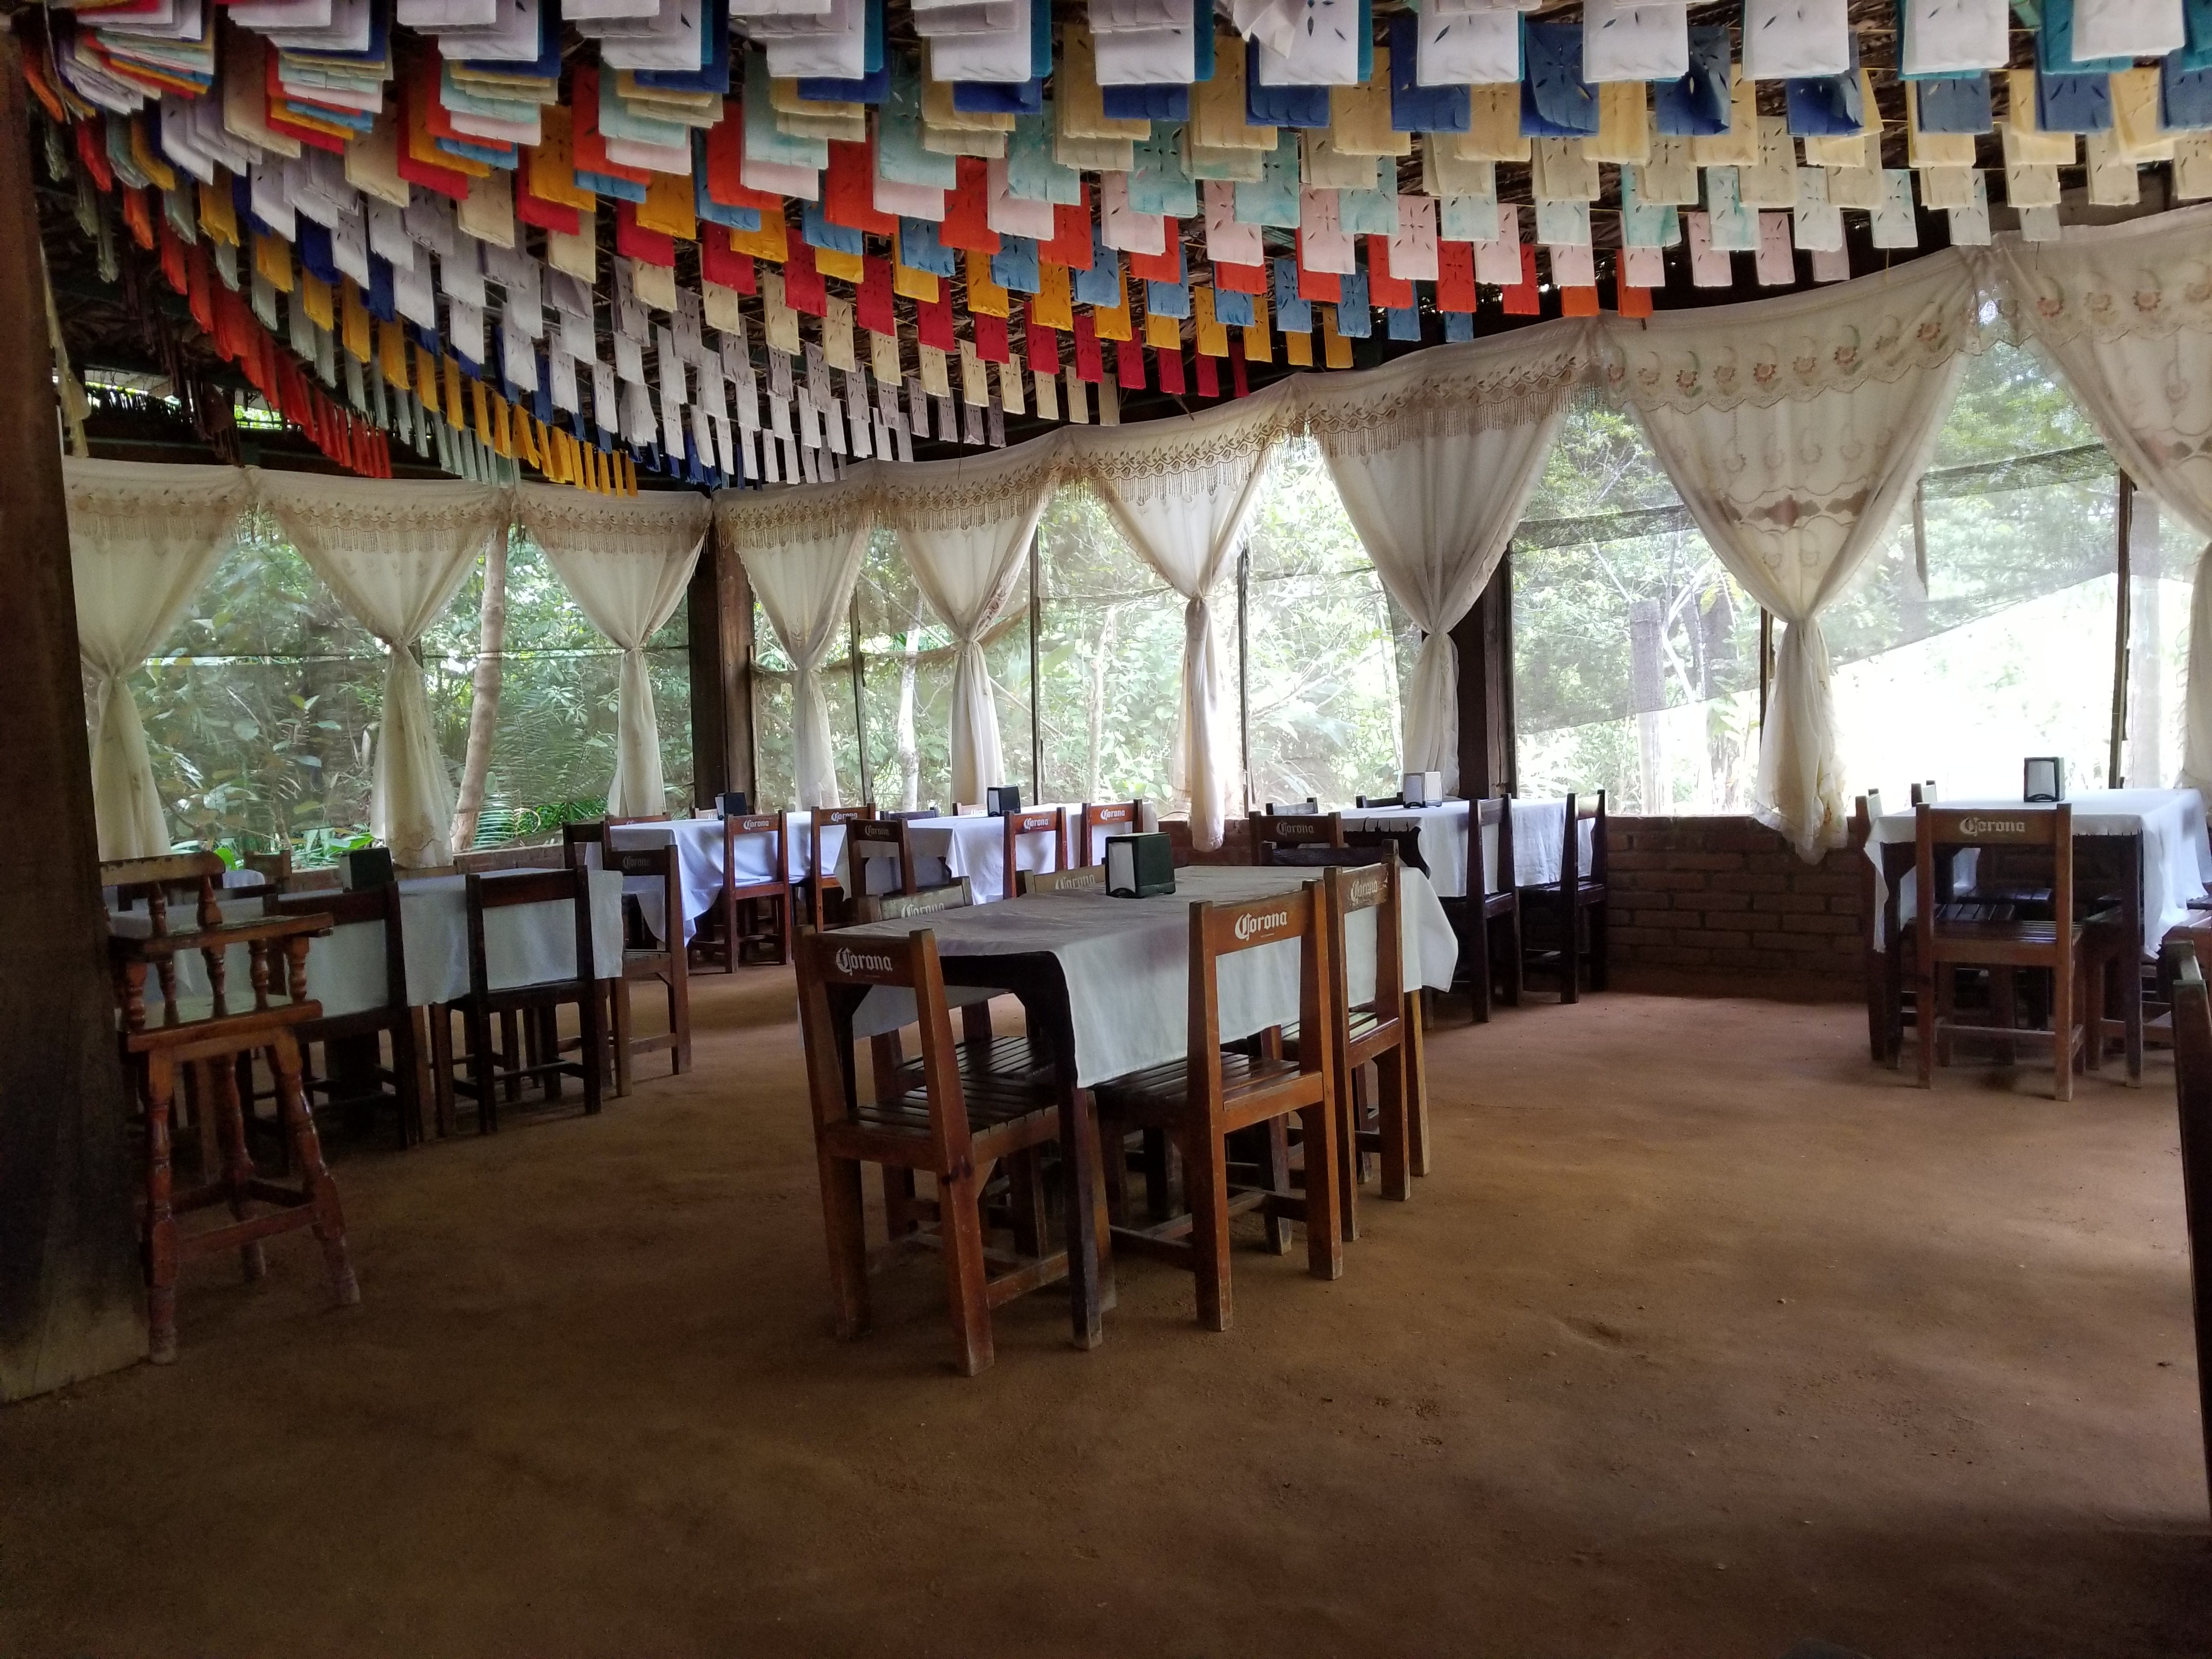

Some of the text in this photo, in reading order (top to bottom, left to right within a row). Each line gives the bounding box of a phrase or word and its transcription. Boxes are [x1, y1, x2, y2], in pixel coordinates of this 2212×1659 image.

[1100, 809, 1125, 821] Corona
[743, 820, 769, 831] Corona
[1024, 817, 1048, 830] Corona
[1276, 822, 1314, 837] Corona
[1960, 817, 2025, 836] Corona
[865, 825, 889, 836] Corona
[623, 856, 651, 869] Corona
[1235, 911, 1288, 941] Corona
[836, 947, 893, 976] Corona
